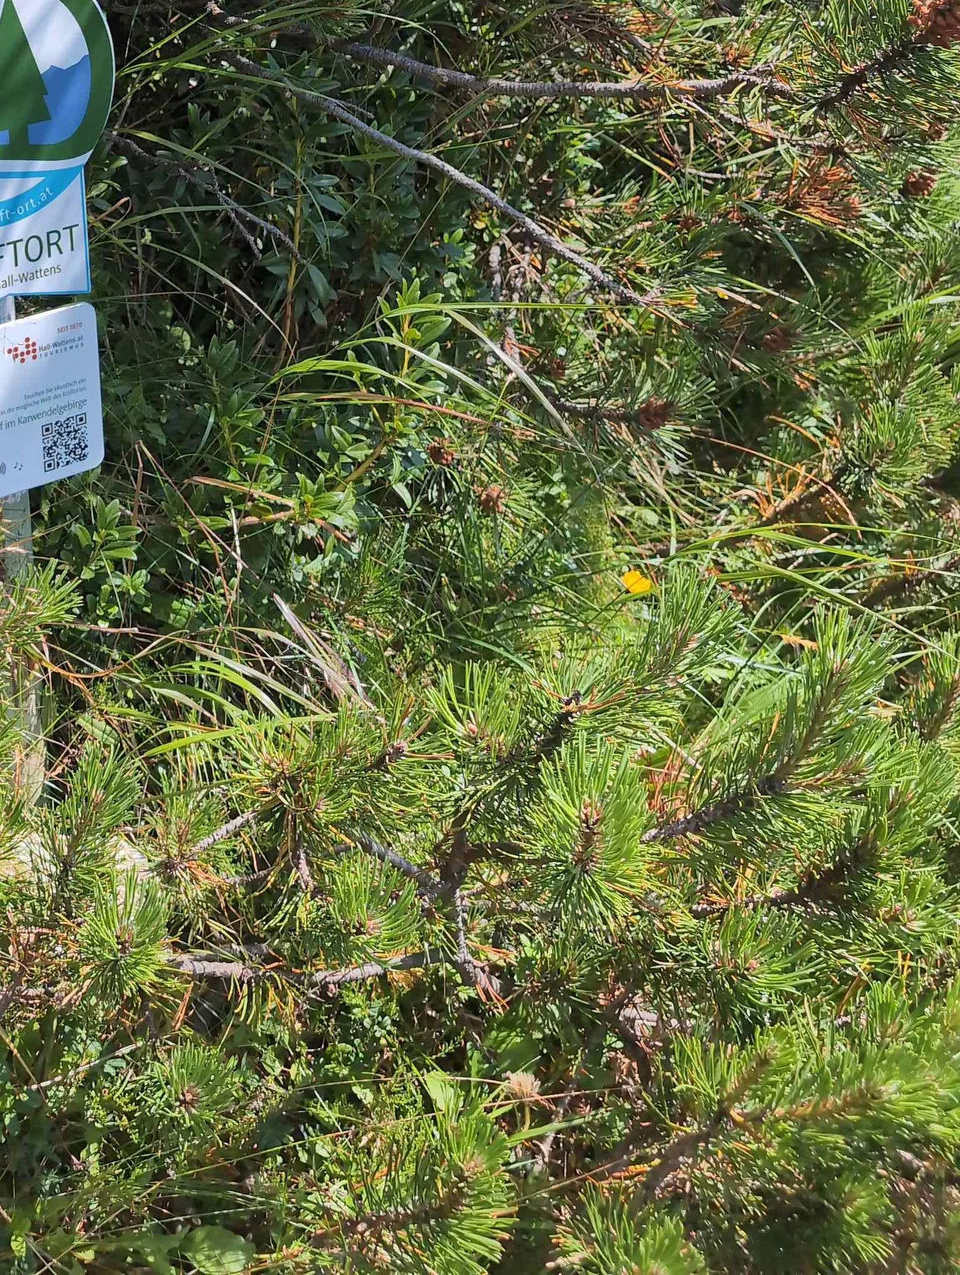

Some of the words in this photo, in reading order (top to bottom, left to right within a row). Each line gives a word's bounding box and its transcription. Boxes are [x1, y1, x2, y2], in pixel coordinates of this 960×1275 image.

[39, 334, 84, 352] Hall-Wattens.at
[40, 343, 85, 358] TOURISMUS
[5, 419, 16, 429] im
[17, 398, 88, 425] Karwendelgebirge
